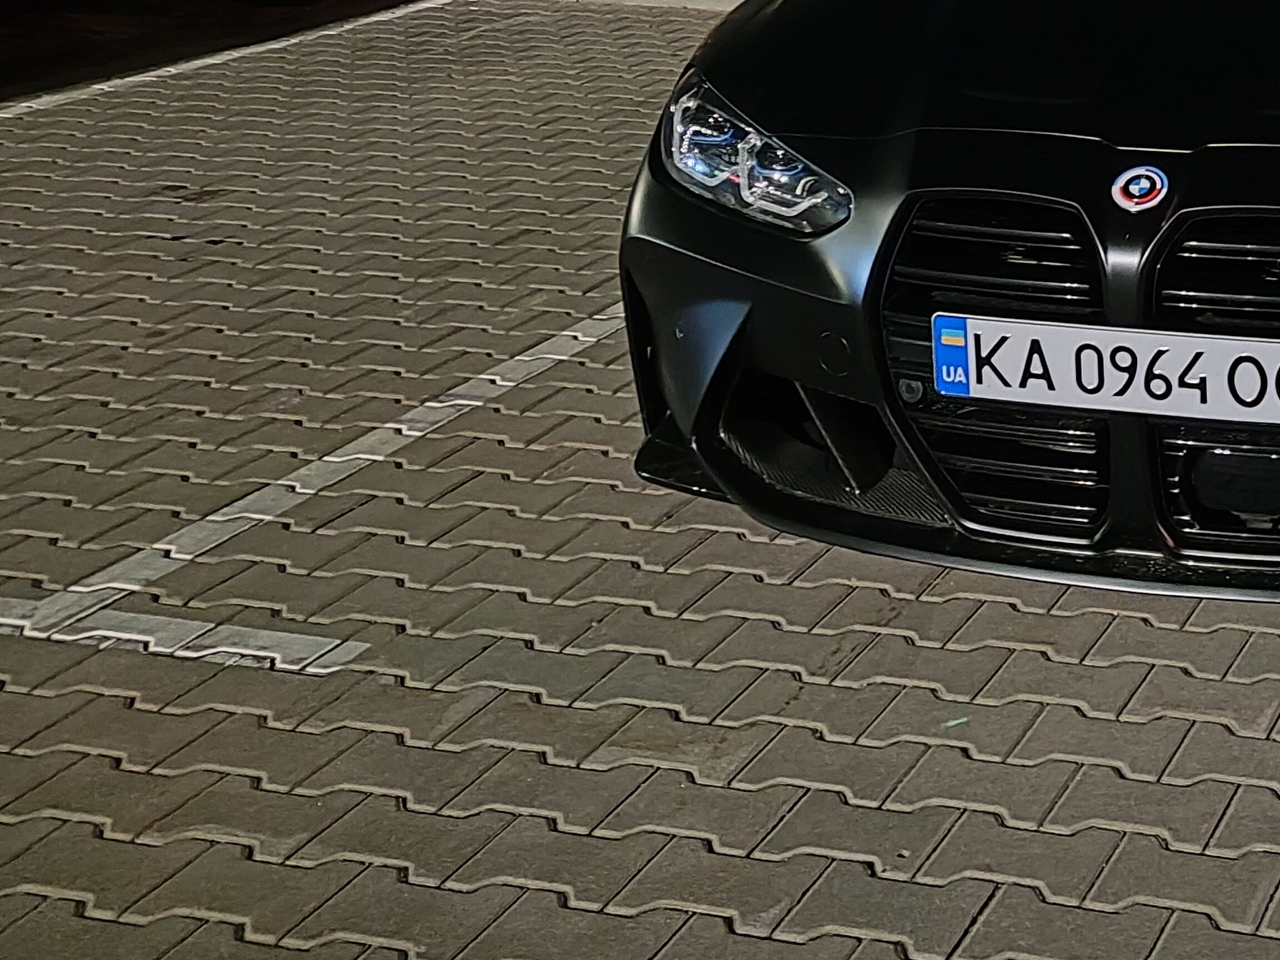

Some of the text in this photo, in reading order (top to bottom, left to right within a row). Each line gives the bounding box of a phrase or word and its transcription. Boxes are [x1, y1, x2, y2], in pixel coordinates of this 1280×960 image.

[942, 365, 967, 384] UA
[973, 332, 1056, 392] KA
[1074, 343, 1208, 405] 0964
